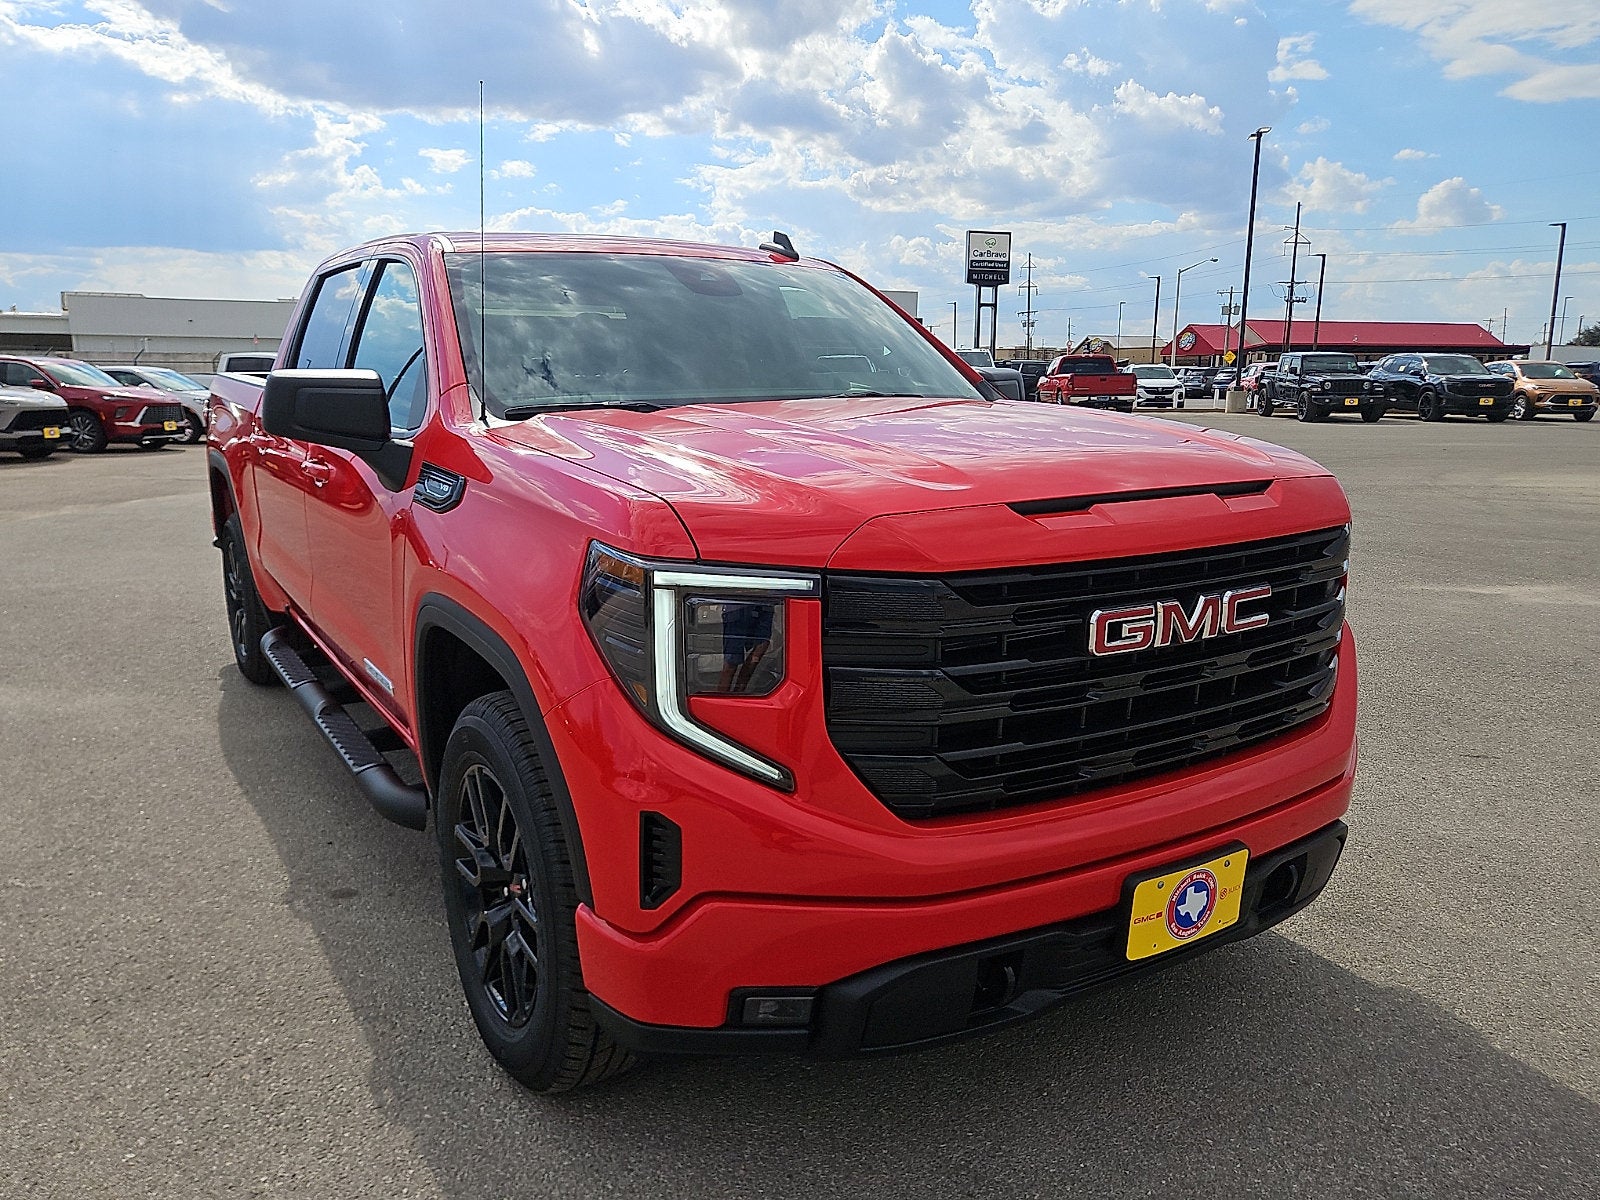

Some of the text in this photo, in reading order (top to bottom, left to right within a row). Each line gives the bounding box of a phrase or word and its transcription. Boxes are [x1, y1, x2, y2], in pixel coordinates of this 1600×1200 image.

[972, 249, 1007, 258] CarBravo
[1088, 582, 1272, 657] GMC
[1133, 913, 1156, 925] GMC
